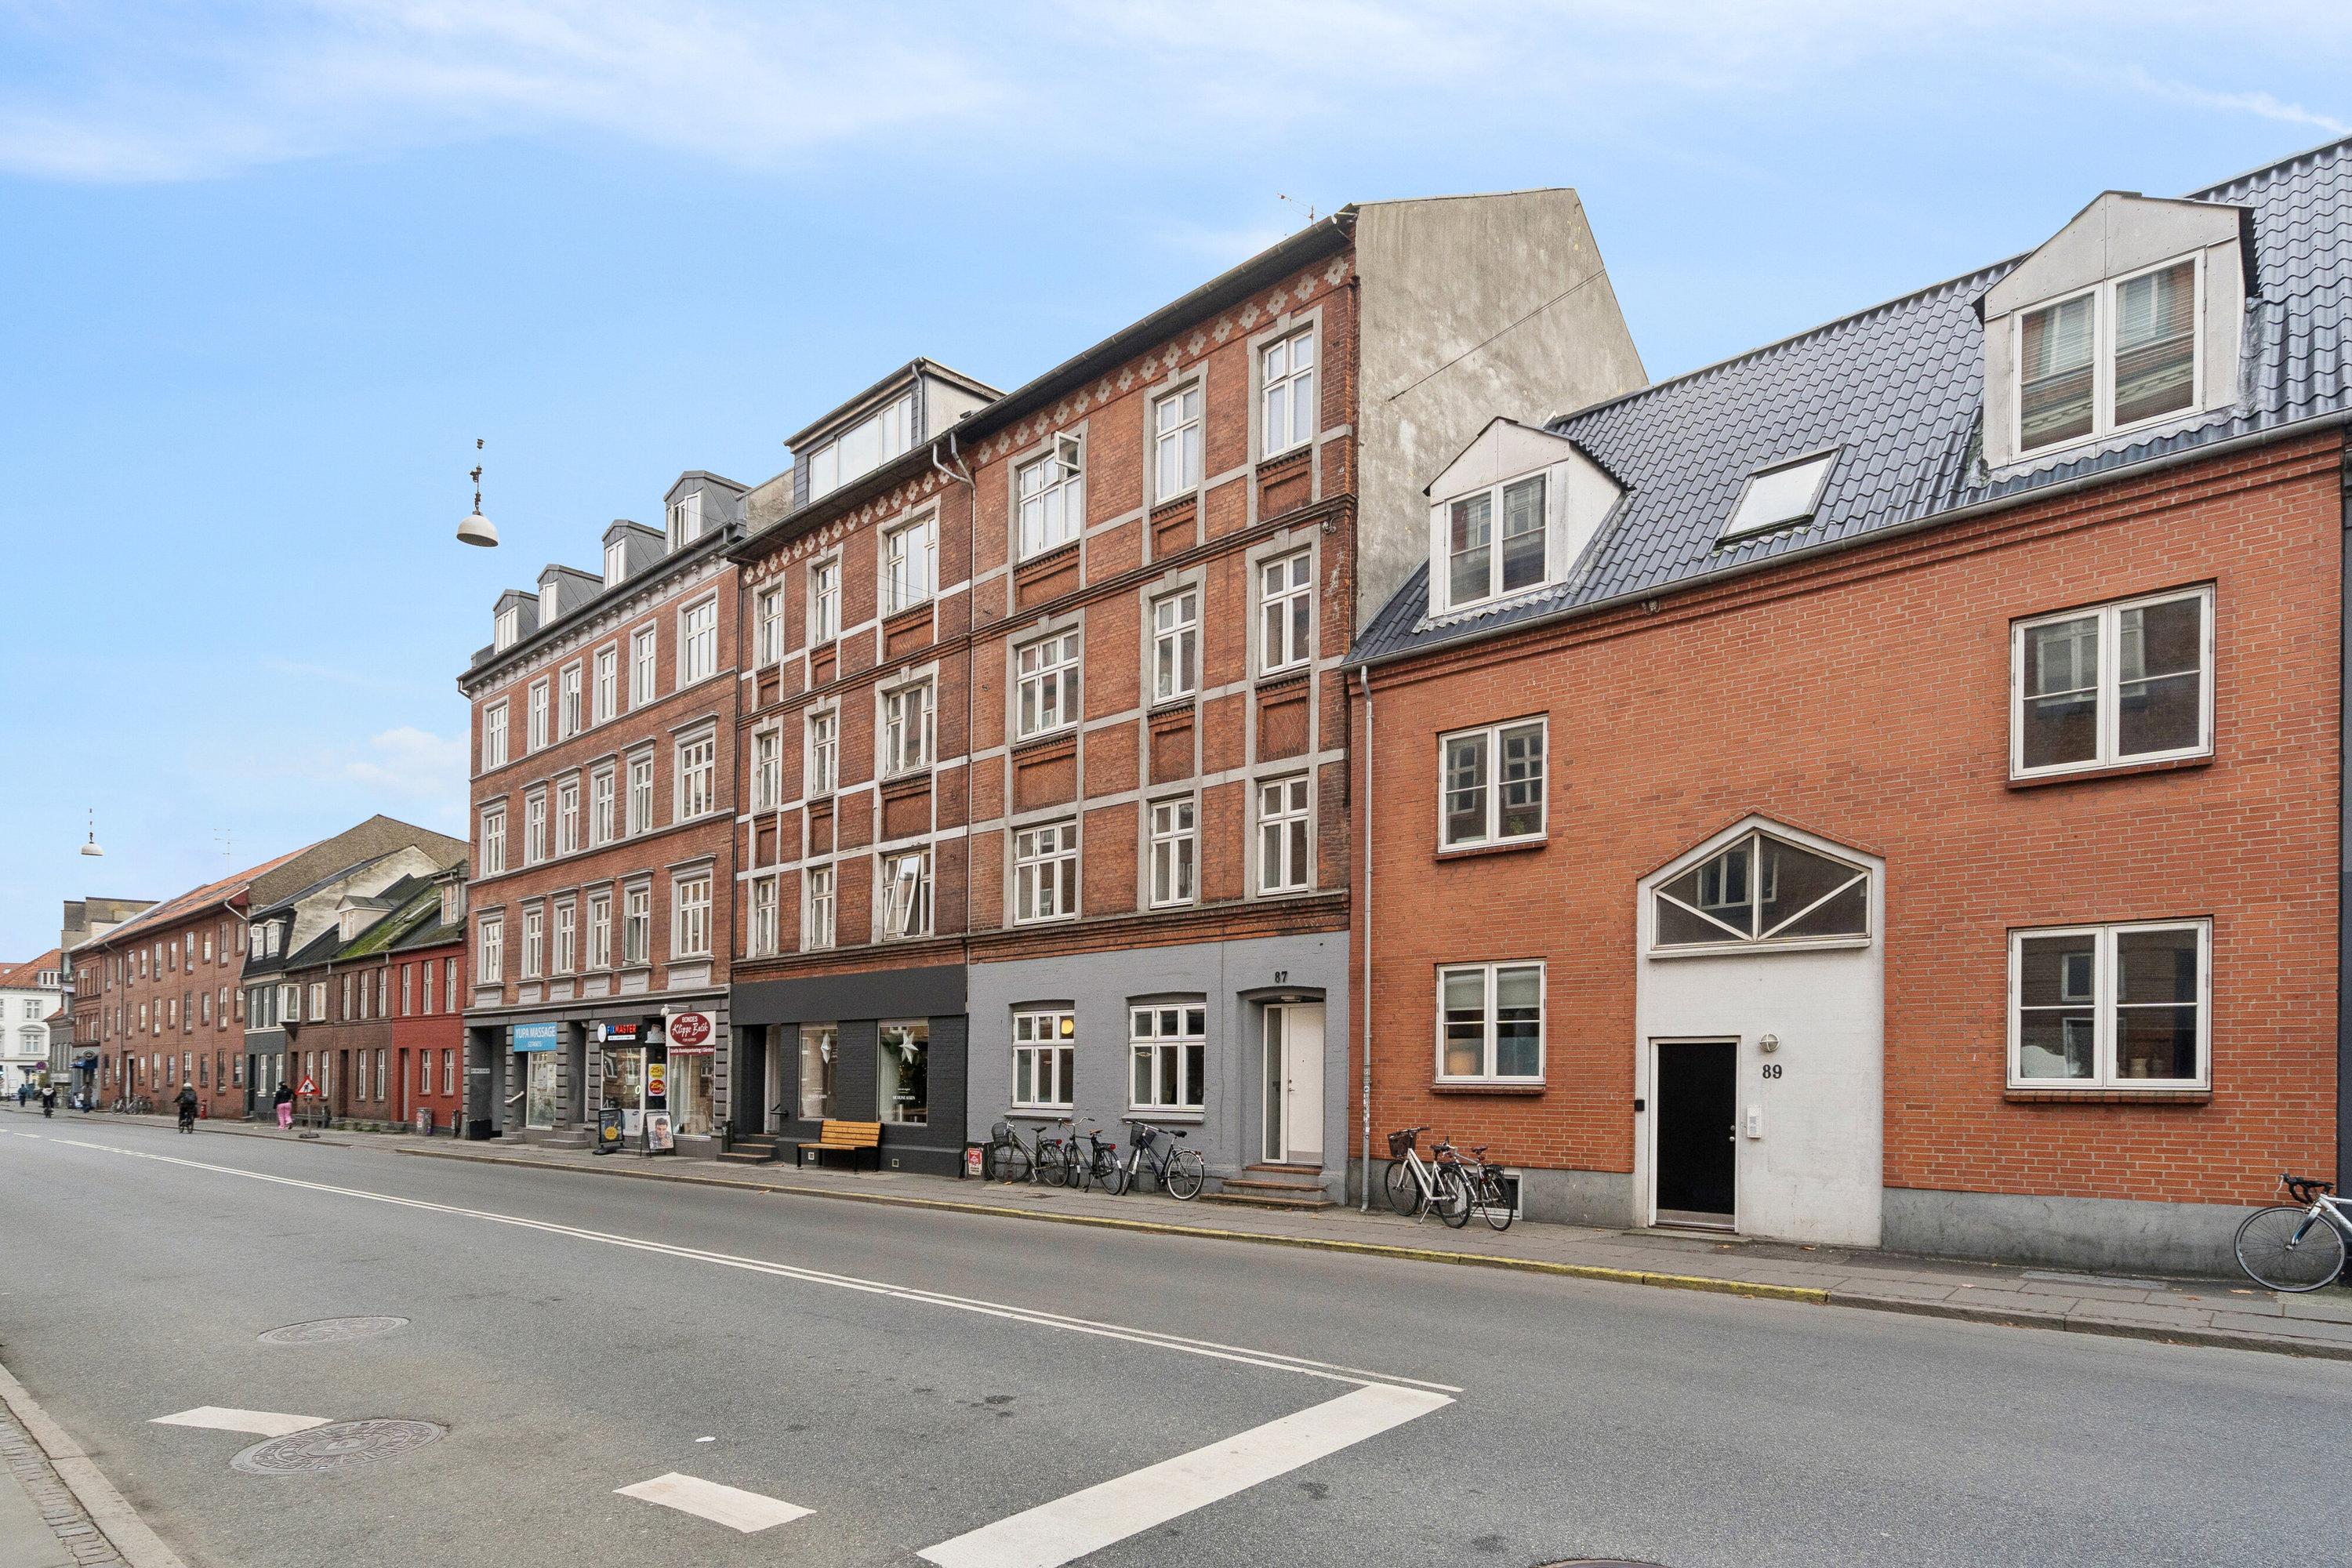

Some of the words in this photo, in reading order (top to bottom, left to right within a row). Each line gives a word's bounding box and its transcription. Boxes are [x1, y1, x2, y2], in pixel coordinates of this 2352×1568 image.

[1275, 971, 1288, 983] 87
[515, 1027, 529, 1039] YUPA
[529, 1025, 556, 1038] MASSAGE
[606, 1024, 637, 1034] FIXMASTER
[651, 1066, 665, 1075] 25%
[1762, 1064, 1782, 1079] 89
[651, 1082, 665, 1091] 25%
